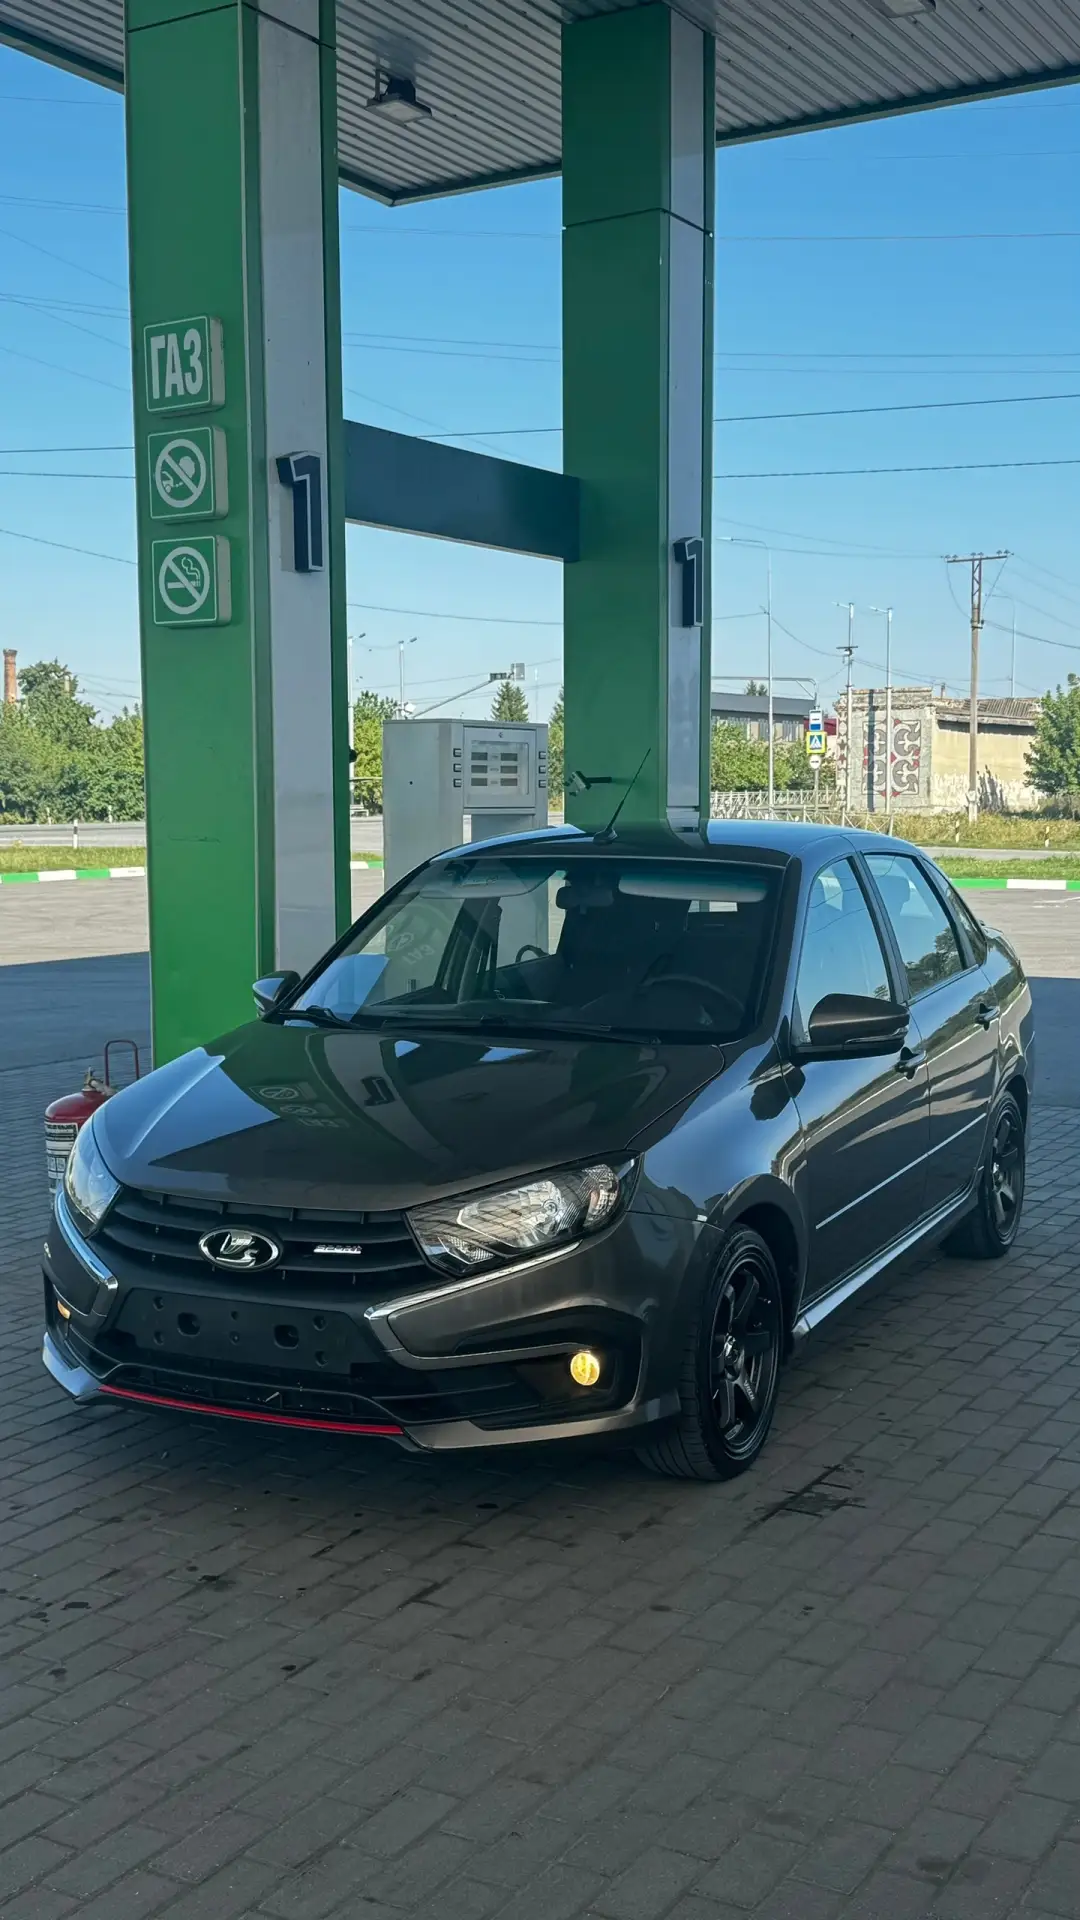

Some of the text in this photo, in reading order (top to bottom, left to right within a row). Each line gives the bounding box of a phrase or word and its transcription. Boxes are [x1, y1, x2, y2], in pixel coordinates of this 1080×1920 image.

[150, 328, 203, 399] ГАЗ
[280, 451, 324, 572] 1
[678, 536, 704, 627] 1
